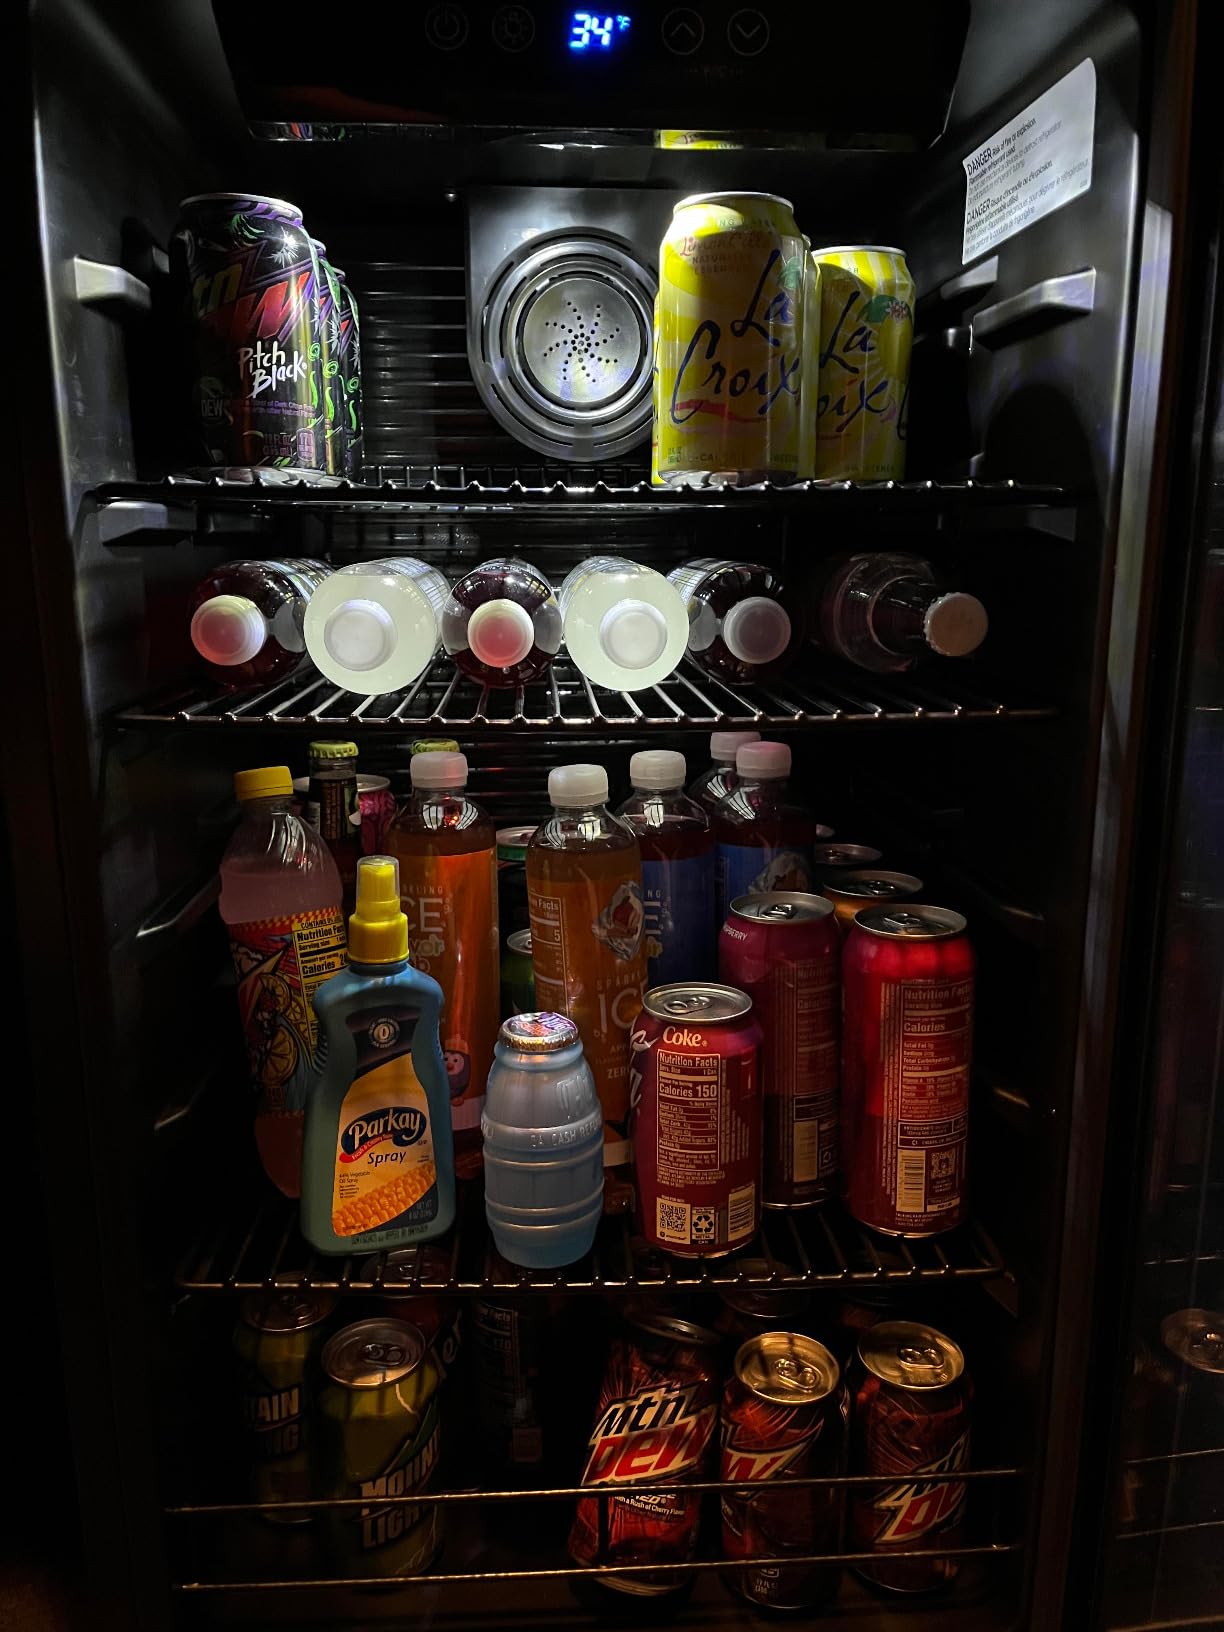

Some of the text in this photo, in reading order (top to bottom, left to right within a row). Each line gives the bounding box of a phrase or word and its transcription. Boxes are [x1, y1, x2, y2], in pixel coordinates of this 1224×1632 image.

[569, 13, 613, 51] 34
[967, 148, 993, 175] DANGER
[967, 198, 991, 224] DANGER
[730, 249, 793, 347] La
[818, 290, 876, 374] La
[239, 340, 286, 381] Pitch
[671, 319, 800, 424] Croix
[245, 351, 306, 399] Black
[297, 928, 333, 942] Nutrition
[554, 930, 561, 942] 5
[302, 960, 336, 975] Calories
[904, 988, 950, 1001] Nutrition
[662, 1025, 702, 1047] Coke
[904, 1022, 945, 1032] Calories
[659, 1052, 718, 1068] Nutrition Facts
[659, 1083, 718, 1098] Calories 150
[348, 1108, 421, 1151] Parkay
[551, 1128, 577, 1146] CASH
[579, 1118, 601, 1137] REFU
[368, 1151, 406, 1167] Spray
[590, 1395, 686, 1439] Mtn
[630, 1498, 645, 1509] Rush
[645, 1502, 652, 1511] of
[651, 1504, 670, 1514] Cherry
